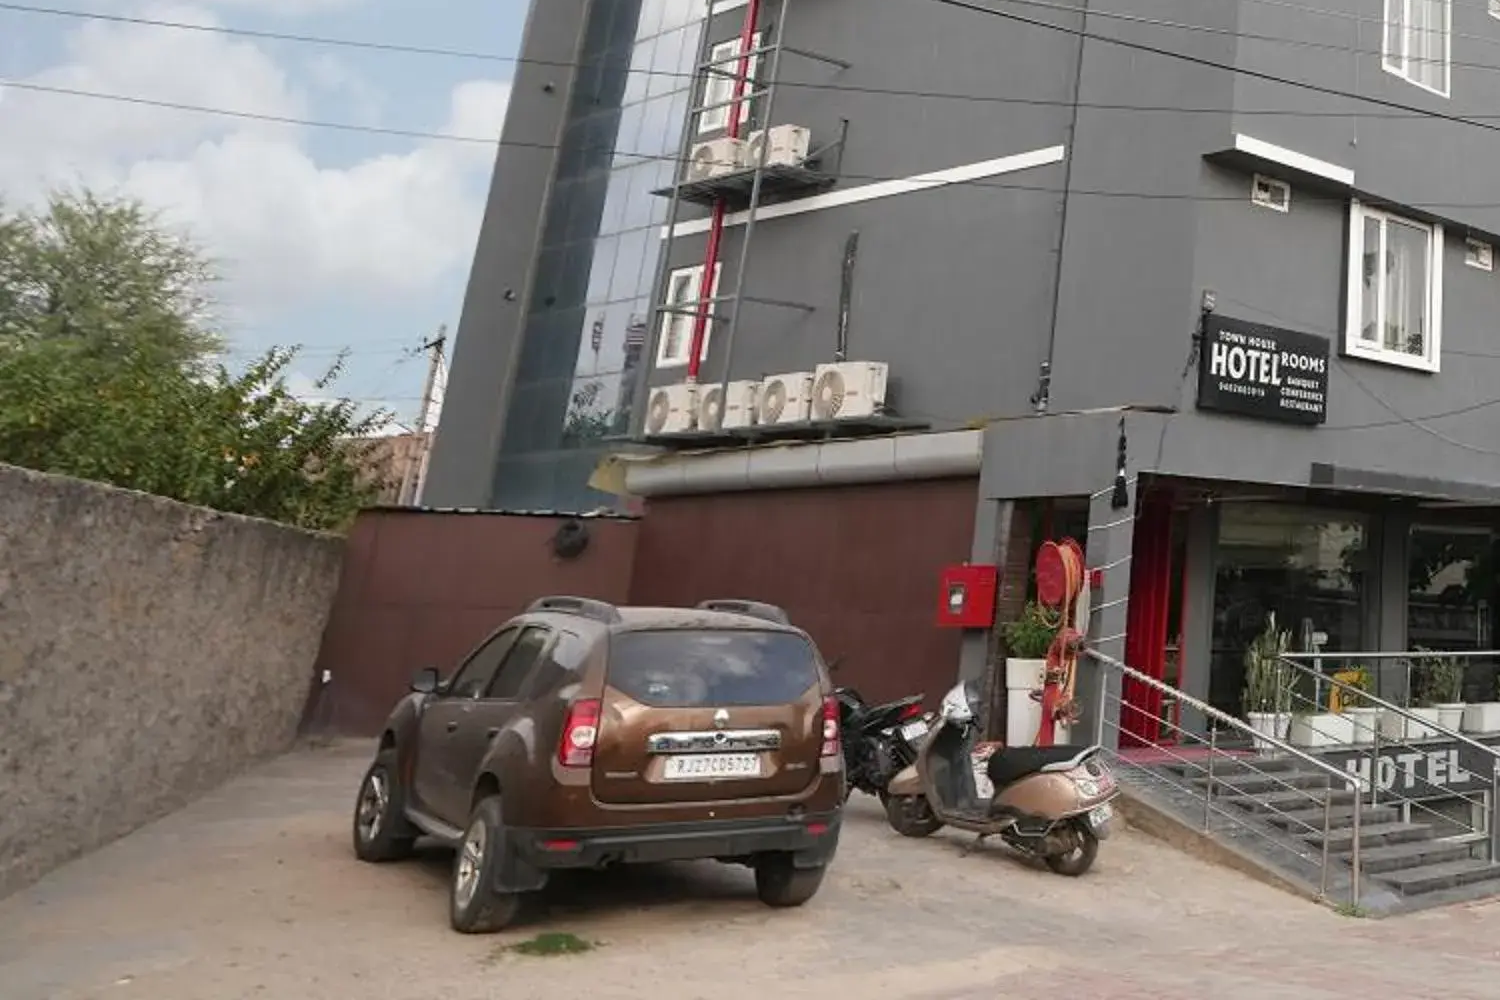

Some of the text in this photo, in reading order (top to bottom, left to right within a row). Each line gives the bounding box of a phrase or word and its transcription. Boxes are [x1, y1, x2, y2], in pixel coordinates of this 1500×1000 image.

[1210, 342, 1325, 386] HOTEL ROOMS
[1345, 750, 1470, 793] HOTEL
